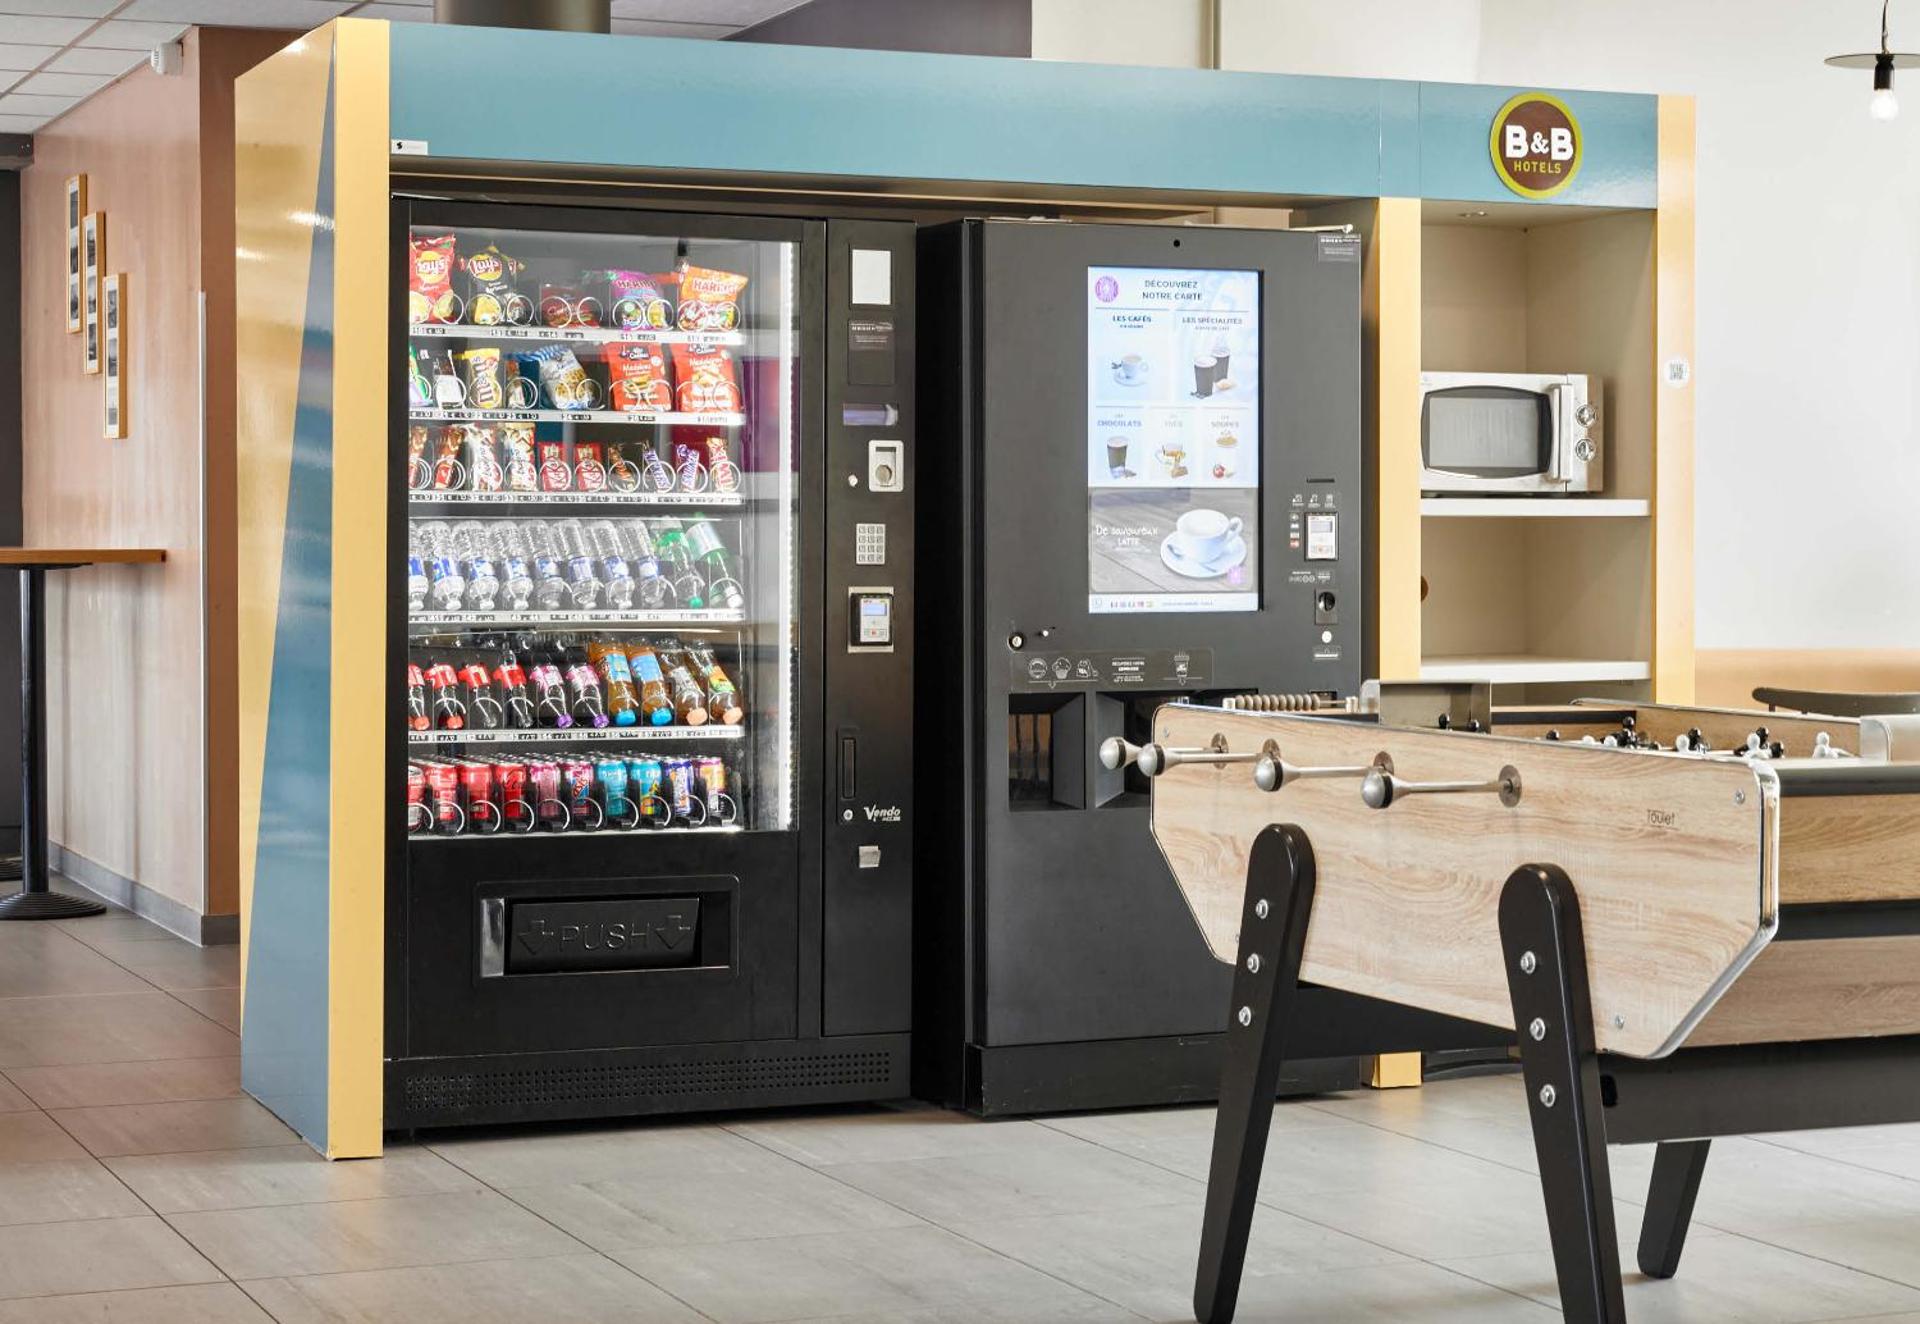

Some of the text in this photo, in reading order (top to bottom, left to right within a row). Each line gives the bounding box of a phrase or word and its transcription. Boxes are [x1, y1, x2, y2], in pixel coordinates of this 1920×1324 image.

[1505, 125, 1574, 161] B&B
[1513, 160, 1562, 174] HOTELS
[1142, 291, 1203, 301] NOTRE CARTE
[1112, 315, 1126, 323] LES
[863, 804, 901, 822] Vendo
[559, 922, 650, 953] PUSH
